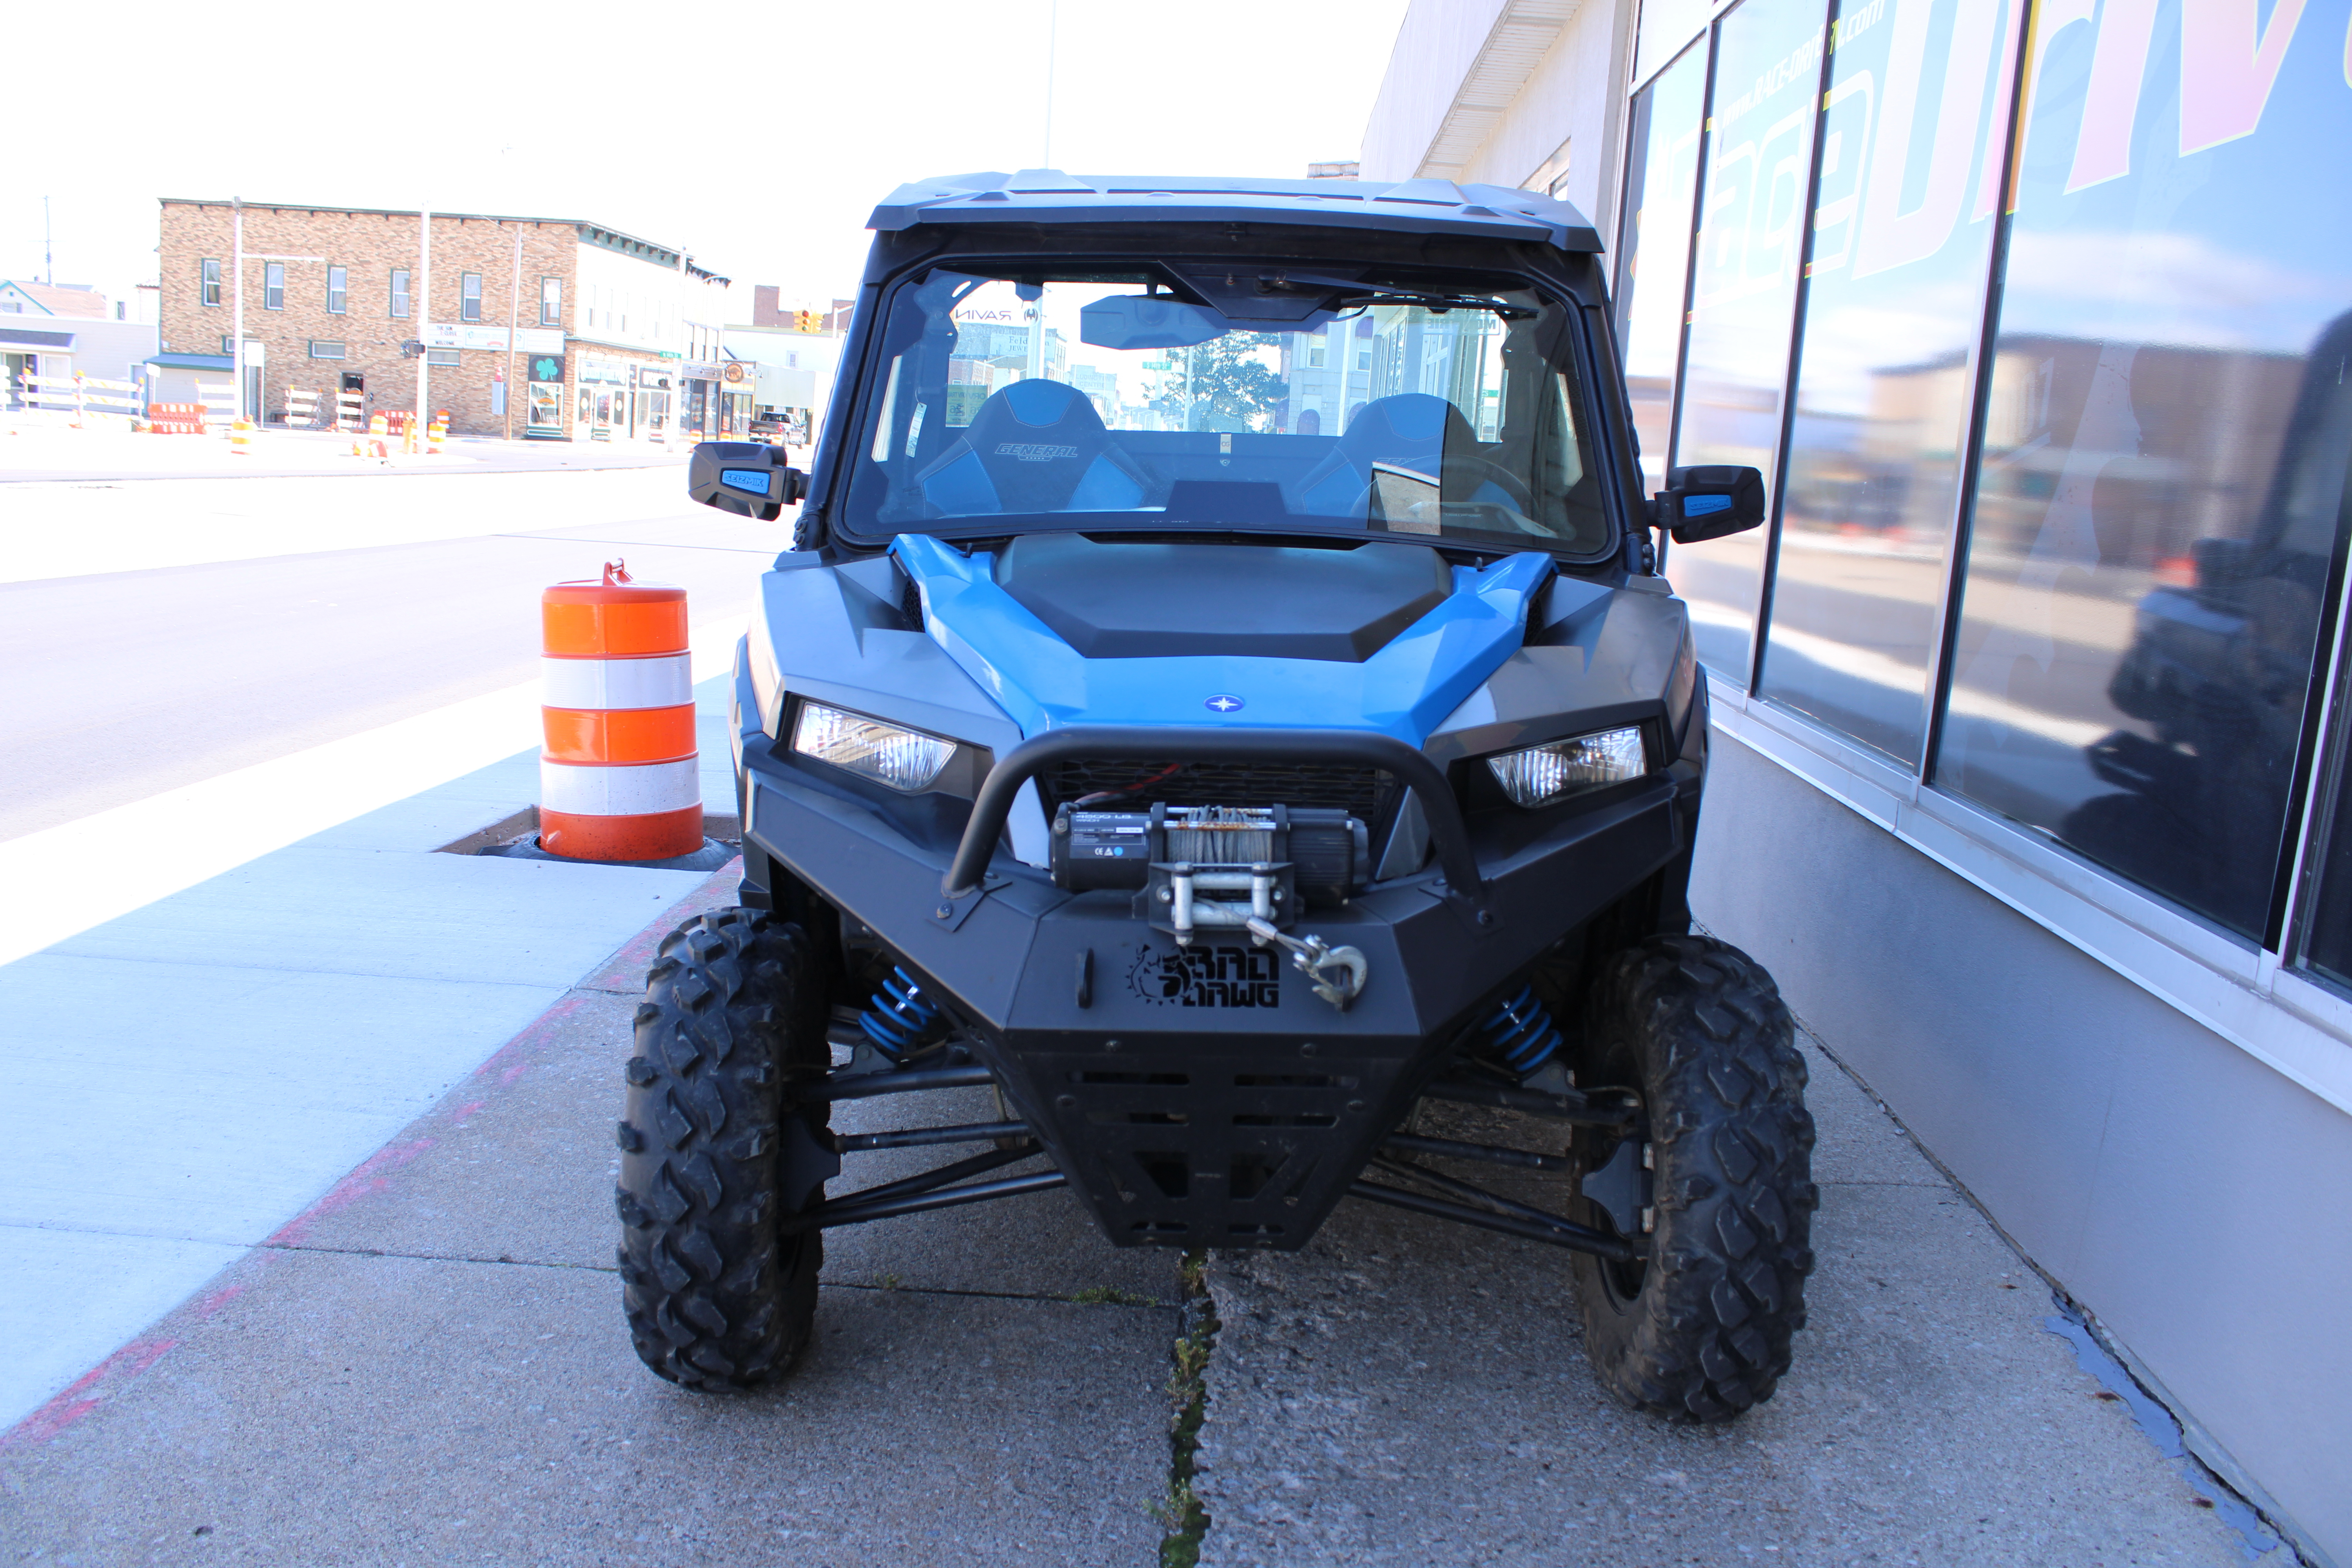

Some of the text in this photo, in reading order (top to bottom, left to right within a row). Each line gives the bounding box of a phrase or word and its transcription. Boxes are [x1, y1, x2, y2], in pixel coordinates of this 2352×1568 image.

[1009, 336, 1050, 346] Feldn
[995, 443, 1078, 457] GENERAL
[726, 474, 764, 487] SEIZMIK
[1690, 499, 1729, 510] SEIZMIK
[1186, 946, 1279, 980] BAD
[1182, 982, 1279, 1008] DAWG
